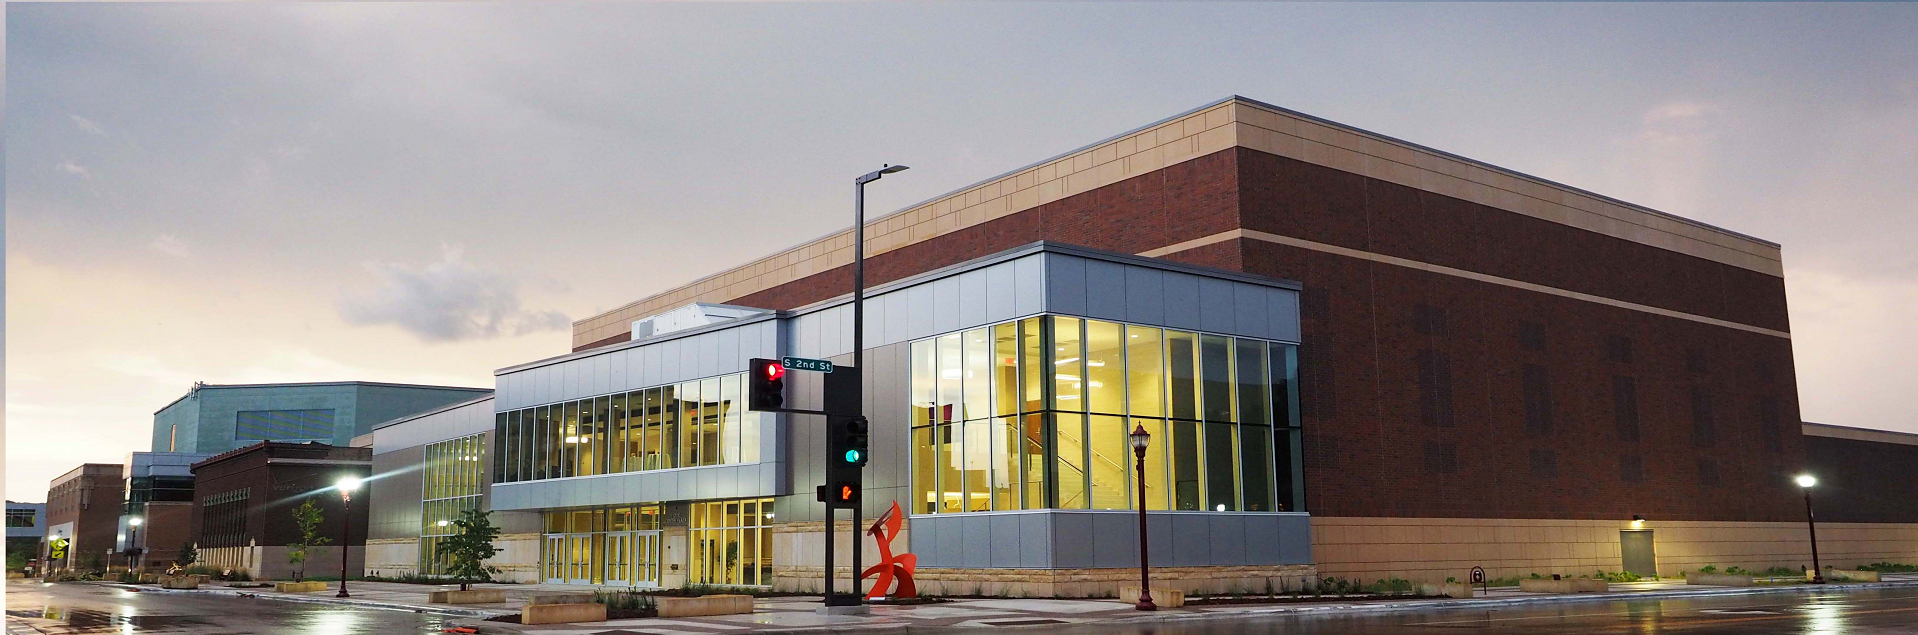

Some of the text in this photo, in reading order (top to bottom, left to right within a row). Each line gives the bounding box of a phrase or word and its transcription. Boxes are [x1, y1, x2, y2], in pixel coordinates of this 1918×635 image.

[784, 358, 831, 370] S 2nd St
